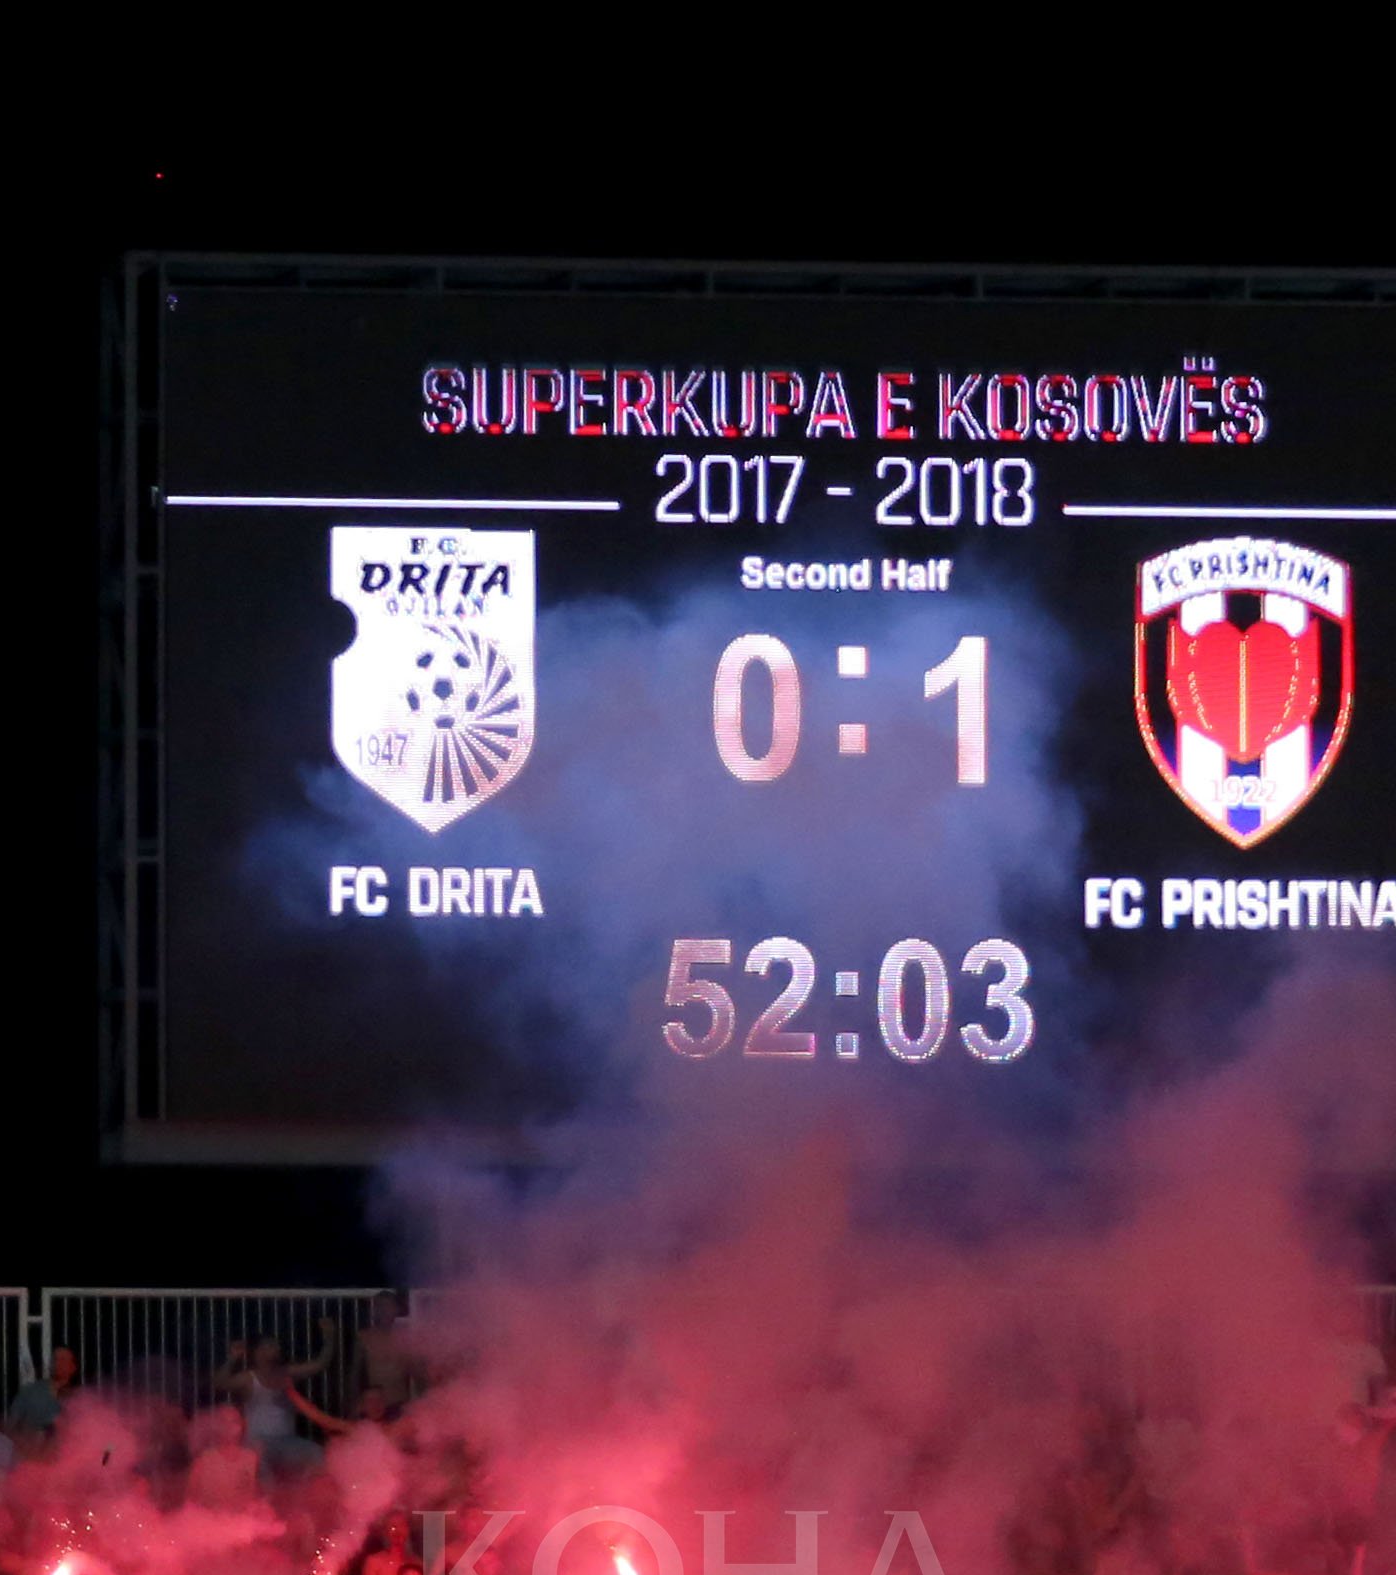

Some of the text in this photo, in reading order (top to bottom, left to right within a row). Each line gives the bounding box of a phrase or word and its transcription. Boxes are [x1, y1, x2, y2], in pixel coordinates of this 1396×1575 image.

[421, 355, 1268, 444] SUPERKUPA E KOSOVËS
[655, 453, 805, 524] 2017
[874, 456, 1033, 527] 2018
[360, 561, 511, 597] DRITA
[740, 556, 954, 592] Second Half
[1153, 552, 1331, 595] FC PRISHTINA
[355, 734, 408, 766] 1947
[329, 865, 546, 918] FC DRITA
[1083, 877, 1145, 930] FC
[662, 936, 1036, 1063] 52:03
